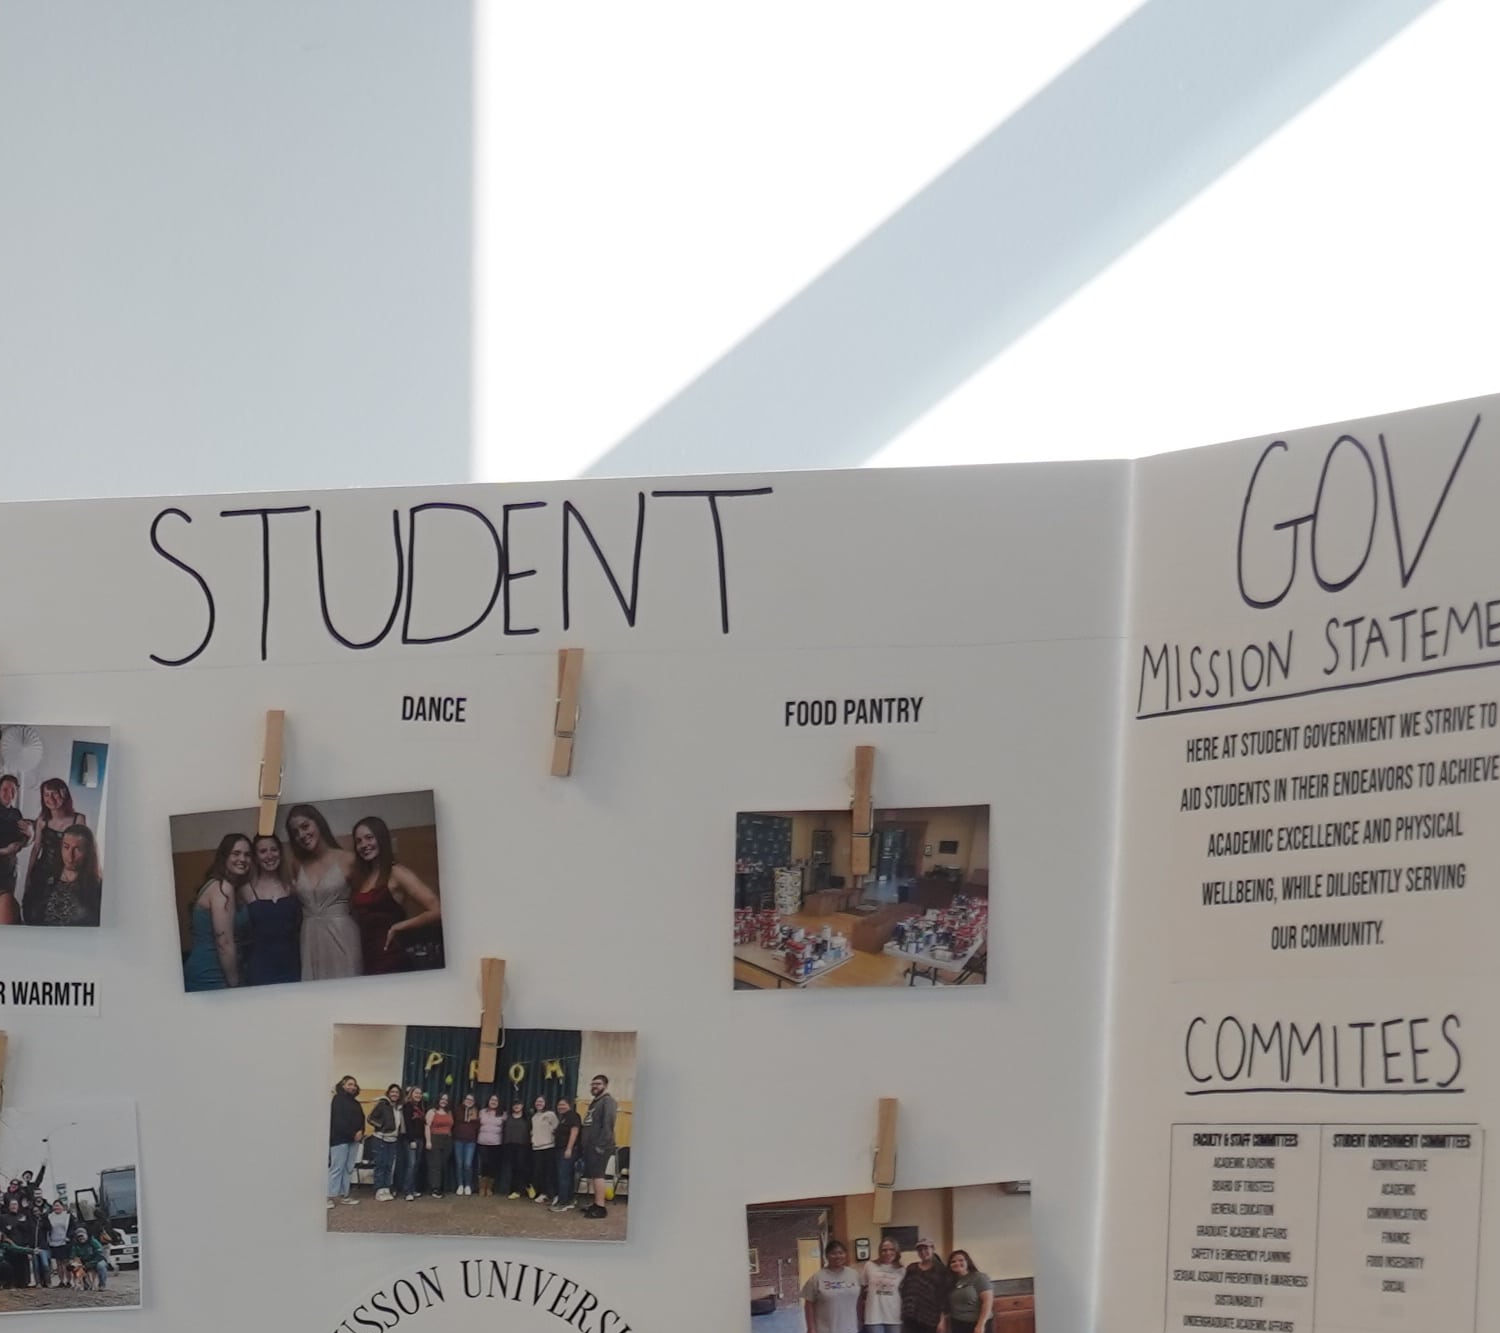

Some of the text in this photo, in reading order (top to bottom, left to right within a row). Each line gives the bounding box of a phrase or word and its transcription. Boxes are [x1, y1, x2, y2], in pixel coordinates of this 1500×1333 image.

[1238, 414, 1481, 609] GOV
[149, 486, 773, 666] STUDENT
[1137, 629, 1293, 712] MISSION
[401, 696, 467, 724] DANCE
[785, 696, 923, 727] FOOD PANTRY
[1187, 702, 1497, 762] HERE AT STUDENT GOVERNMENT WE STRIVE TO
[1180, 755, 1500, 811] AID STUDENTS IN THEIR ENDEAVORS TO ACHIEVE
[1207, 811, 1463, 857] ACADEMIC EXCELLENCE AND PHYSICAL
[1202, 863, 1466, 905] WELLBEING, WHILE DILIGENTLY SERVING
[1271, 920, 1384, 950] OUR COMMUNITY.
[11, 982, 95, 1007] WARMTH
[1186, 1014, 1461, 1088] COMMITEES
